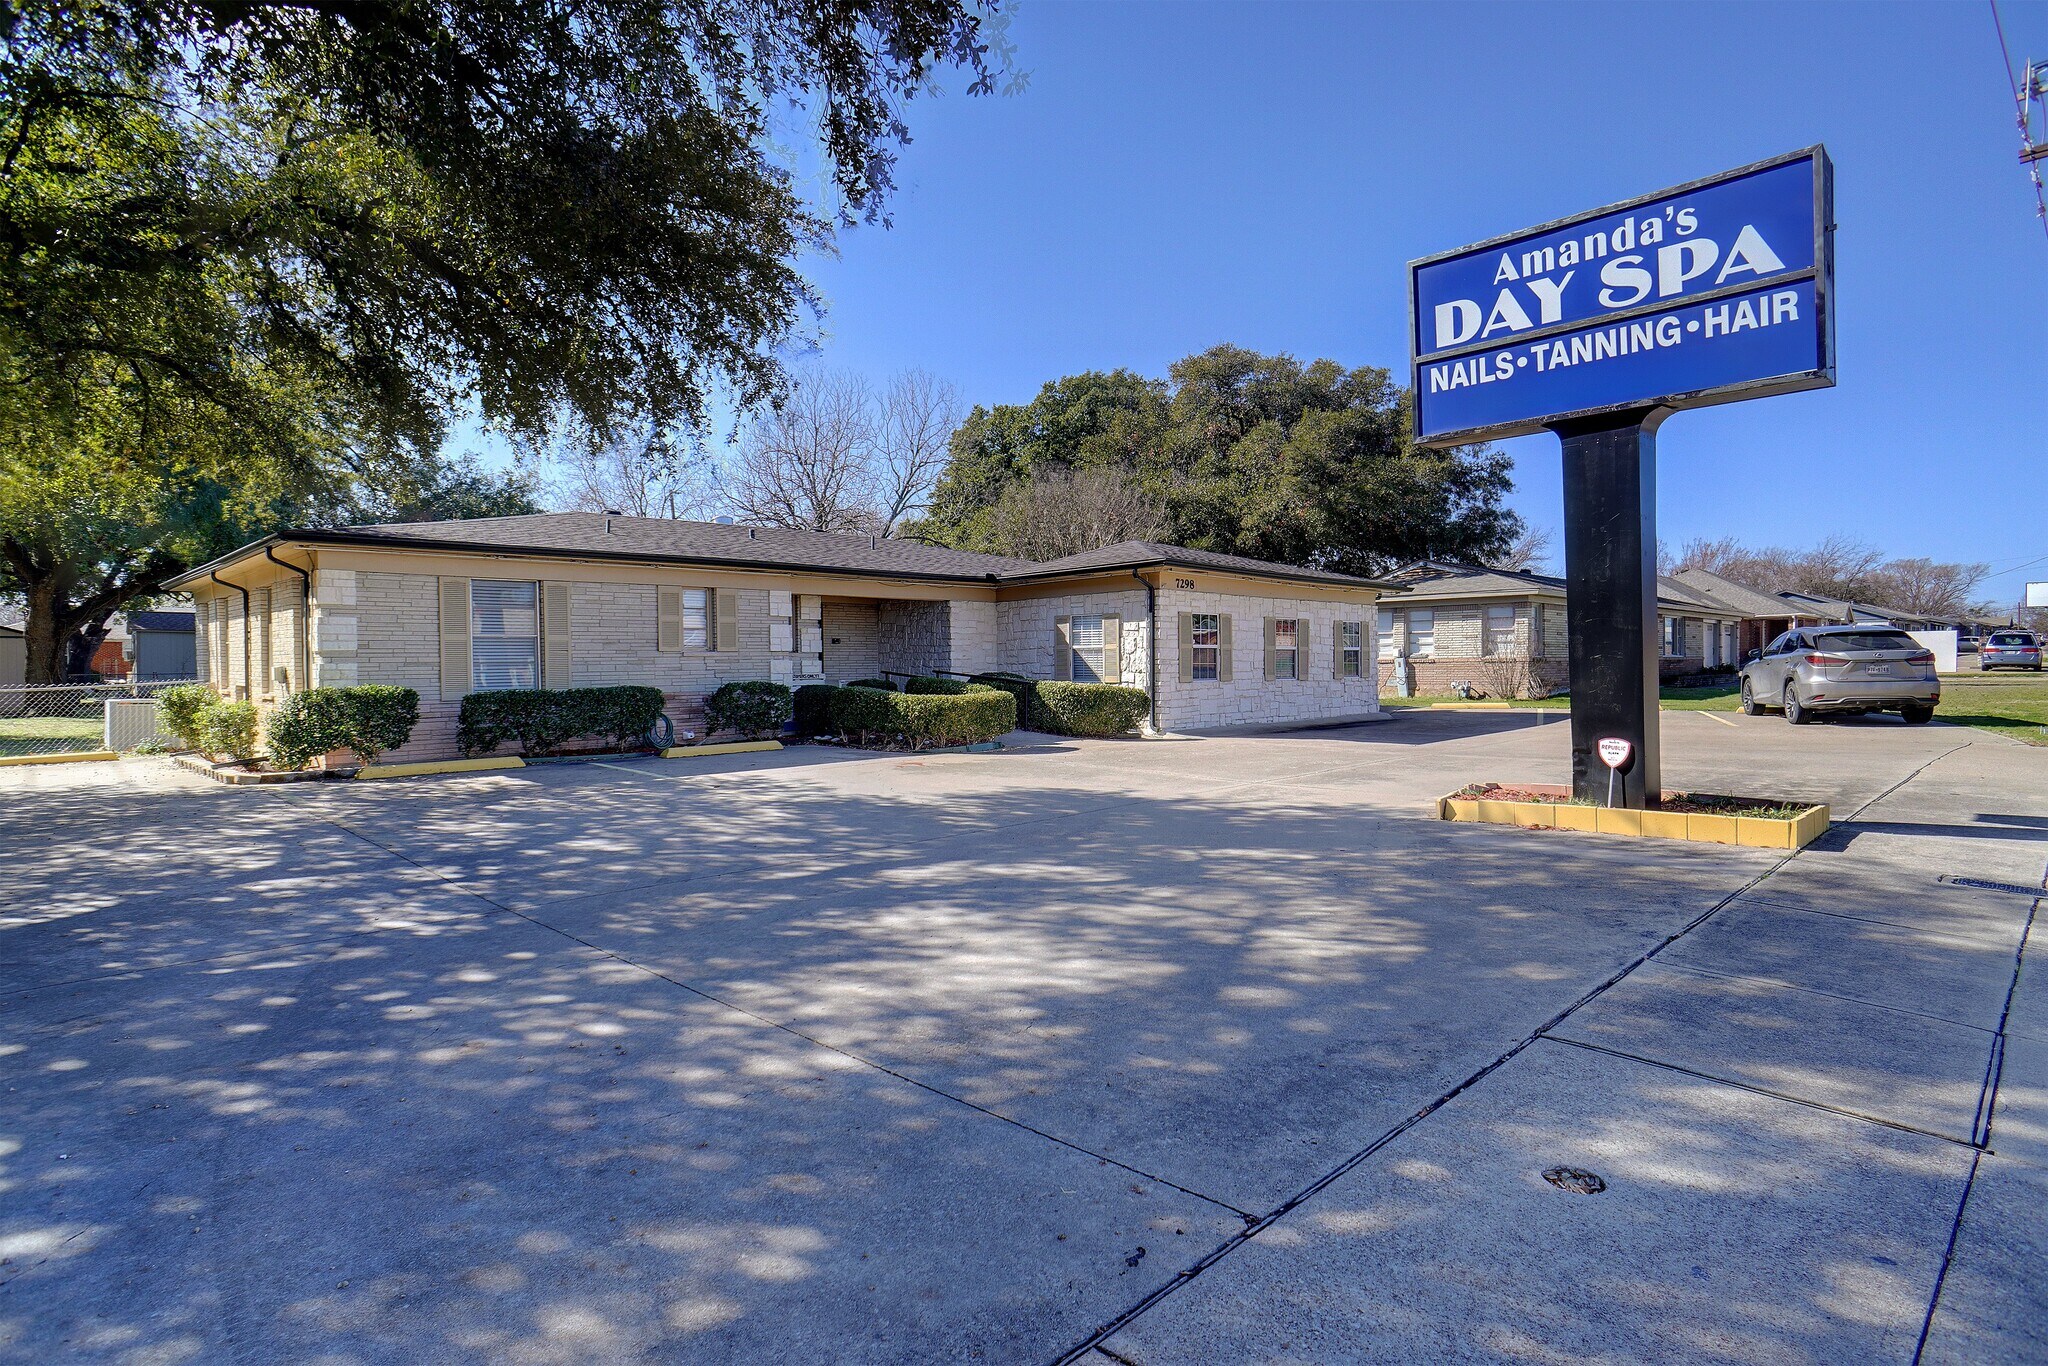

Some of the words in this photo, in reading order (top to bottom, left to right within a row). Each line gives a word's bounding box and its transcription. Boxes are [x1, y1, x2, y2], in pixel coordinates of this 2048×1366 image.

[1434, 270, 1576, 349] DAY
[1598, 224, 1786, 309] SPA
[1493, 205, 1699, 285] Amanda's
[1429, 351, 1515, 394] NAILS
[1530, 315, 1682, 373] TANNING
[1704, 290, 1799, 339] HAIR
[1175, 578, 1195, 589] 7298
